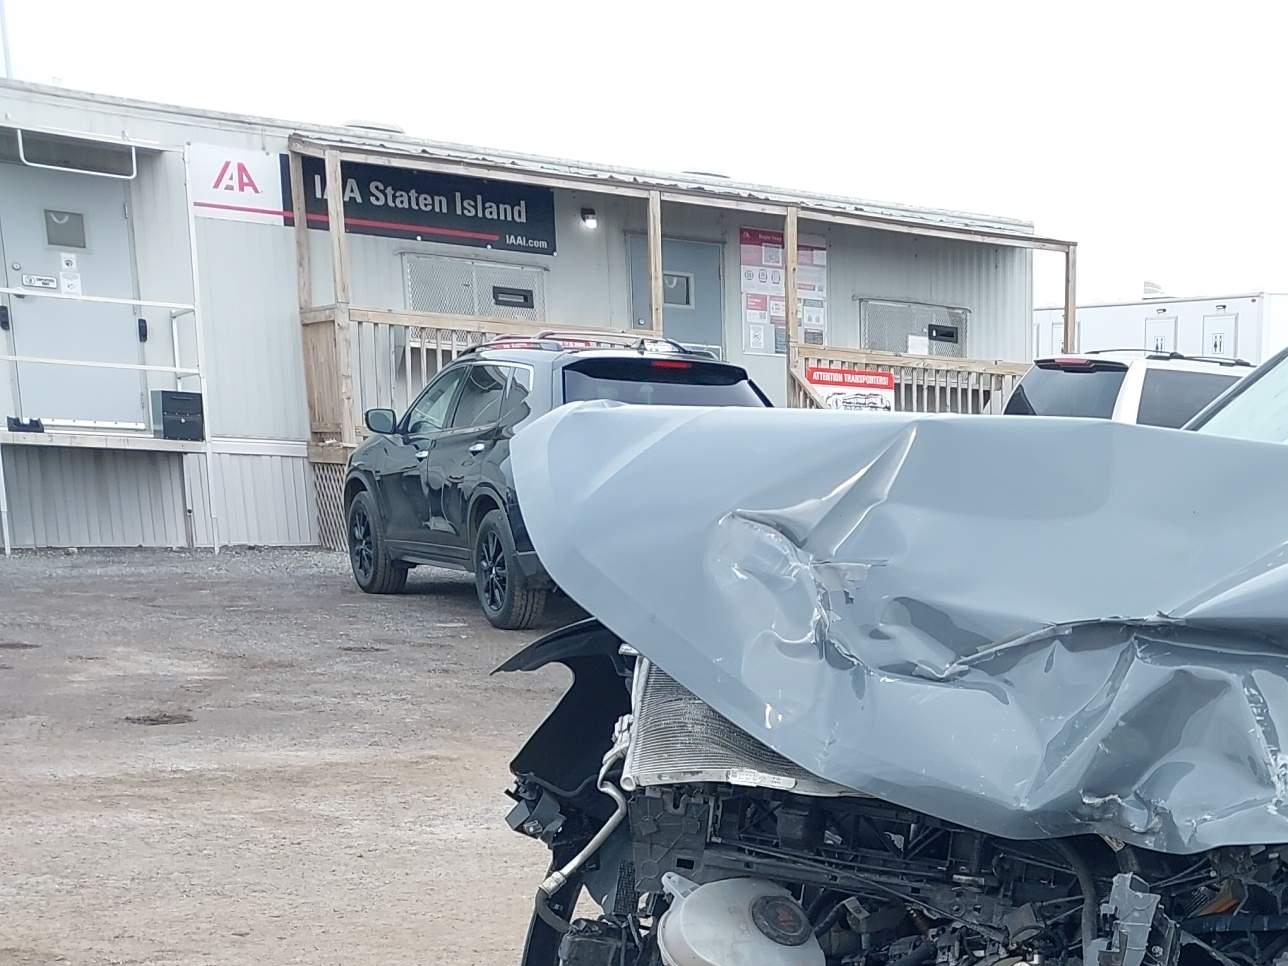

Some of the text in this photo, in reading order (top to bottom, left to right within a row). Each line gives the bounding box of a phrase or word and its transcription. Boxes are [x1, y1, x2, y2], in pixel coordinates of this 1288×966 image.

[314, 174, 527, 223] IA Staten Island
[812, 371, 843, 383] ATTENTION
